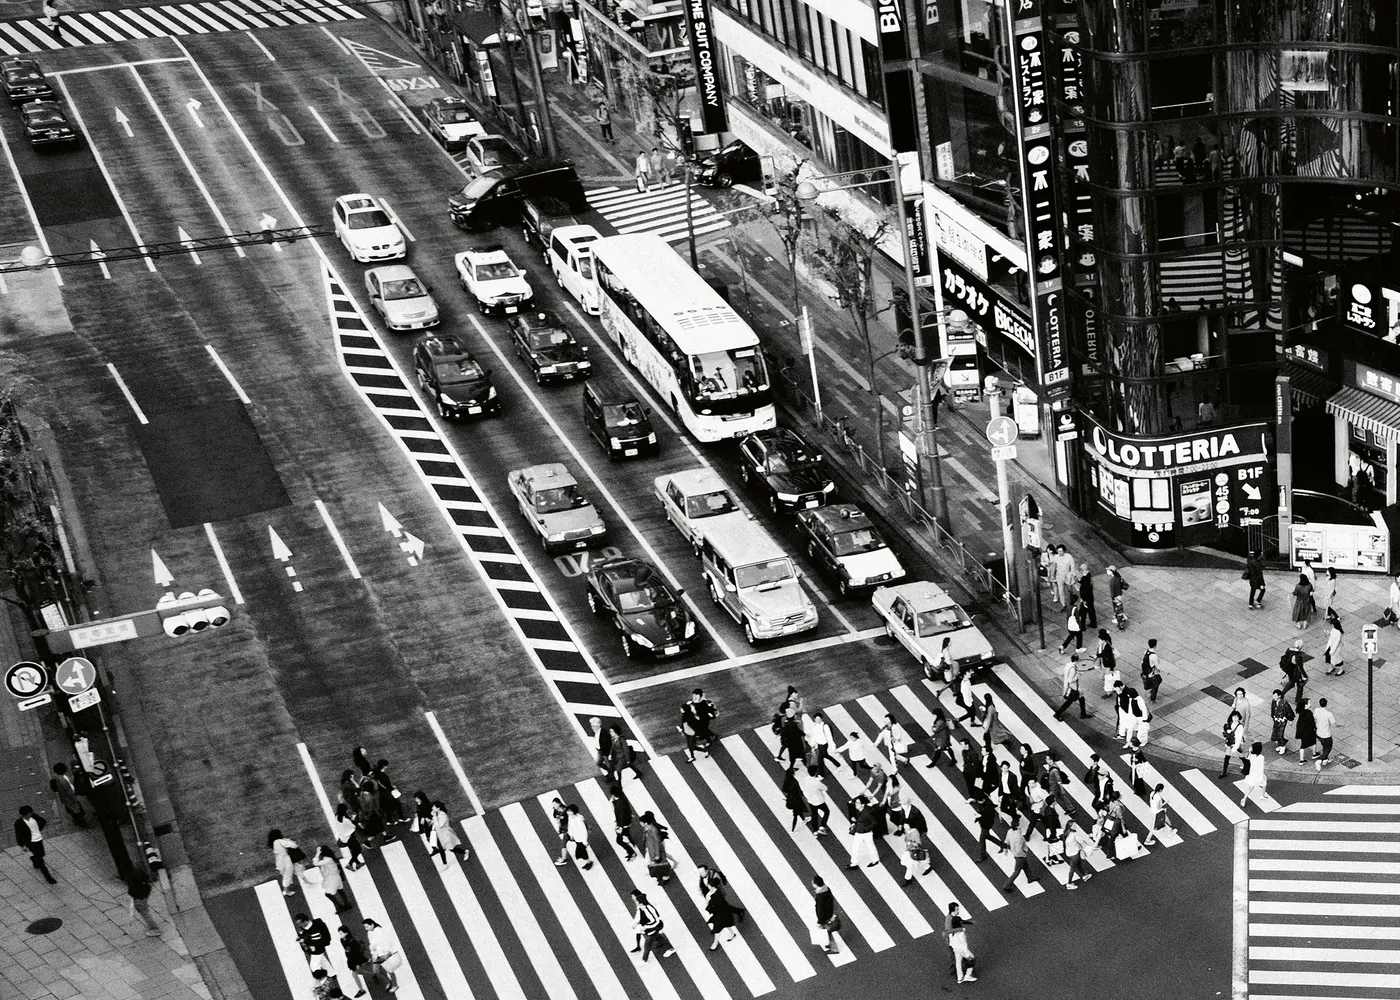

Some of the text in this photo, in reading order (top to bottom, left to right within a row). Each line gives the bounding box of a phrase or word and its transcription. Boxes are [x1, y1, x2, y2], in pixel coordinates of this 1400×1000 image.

[694, 22, 709, 49] SUIT
[699, 51, 719, 108] COMPANY
[1020, 55, 1033, 107] レストラン
[1032, 170, 1053, 250] 不二家
[944, 268, 990, 316] カラオケ
[1049, 308, 1062, 369] LOTTERIA
[1048, 372, 1065, 383] B1F
[1107, 433, 1239, 467] LOTTERIA
[1238, 467, 1263, 480] B1F
[1215, 486, 1229, 497] 45
[1216, 514, 1230, 524] 10
